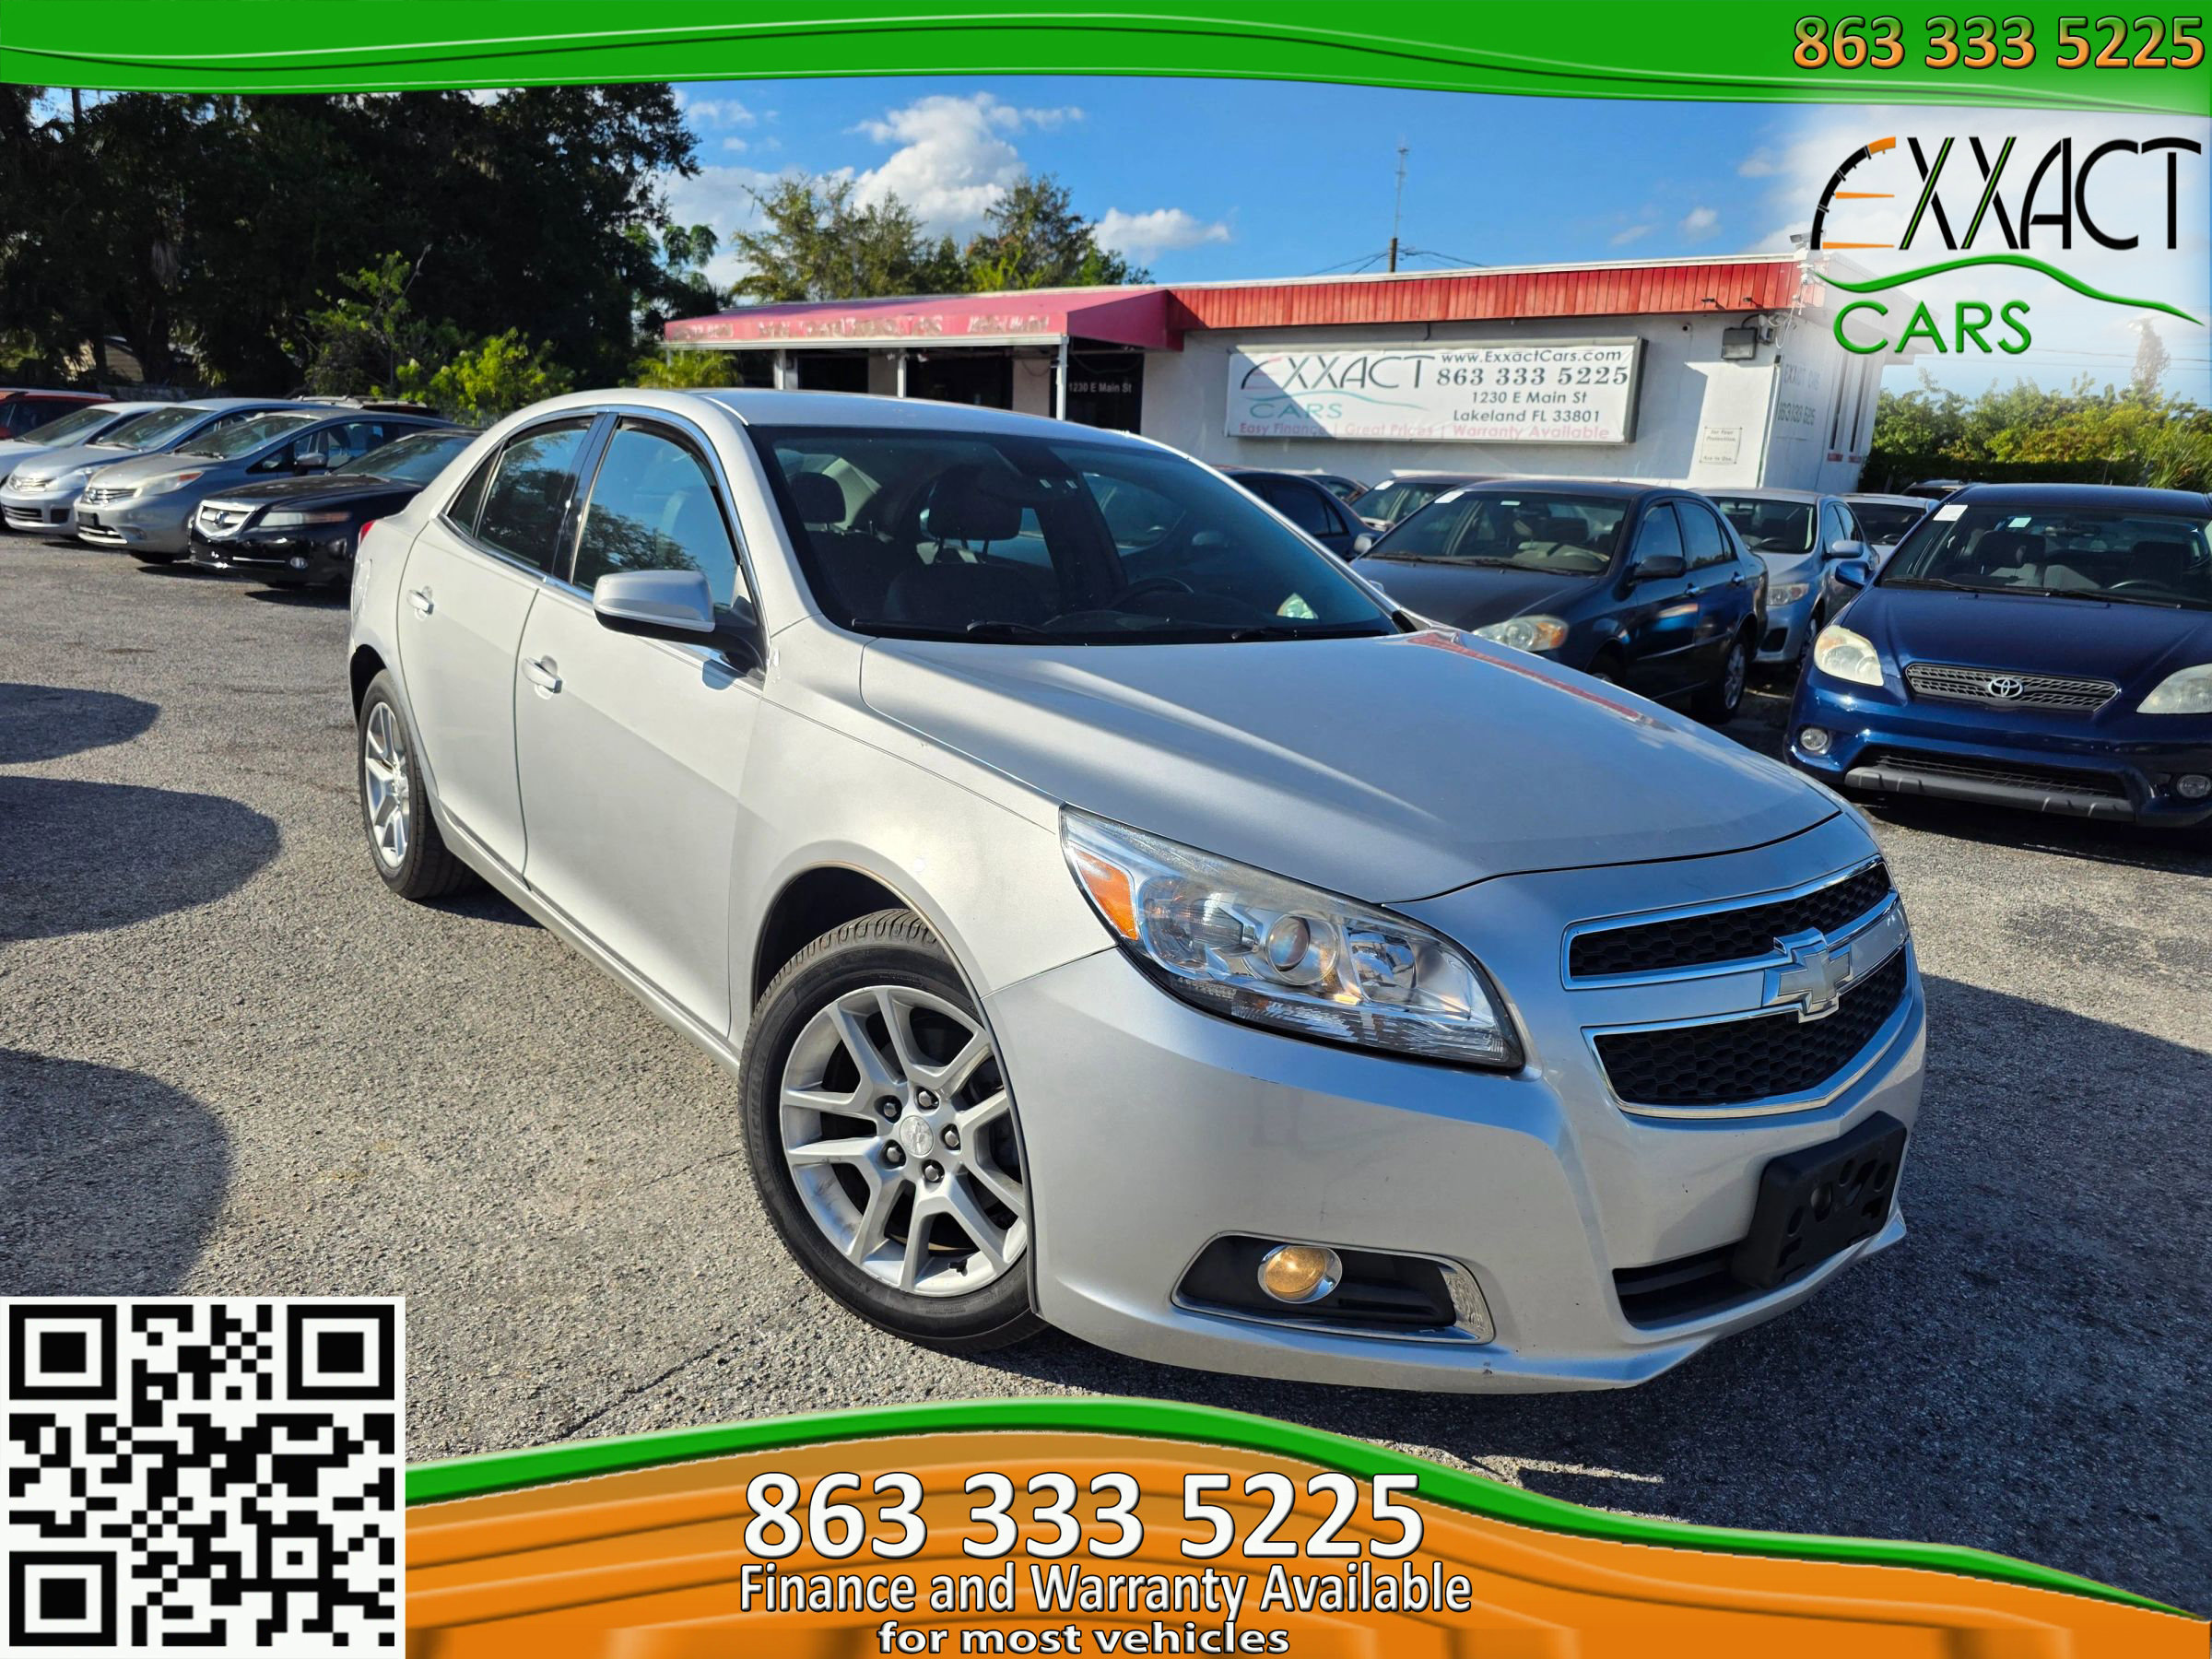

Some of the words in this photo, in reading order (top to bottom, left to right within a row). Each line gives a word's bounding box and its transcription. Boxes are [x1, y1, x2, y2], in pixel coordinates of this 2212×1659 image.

[1441, 349, 1621, 363] www.ExxactCars.com
[1241, 355, 1436, 390] EXXACT
[1437, 368, 1484, 386] 863
[1495, 367, 1546, 385] 333
[1558, 366, 1629, 385] 5225
[1090, 382, 1097, 393] E
[1099, 382, 1120, 393] Main
[1122, 382, 1132, 393] St
[1473, 391, 1507, 404] 1230
[1512, 392, 1521, 404] E
[1526, 391, 1567, 404] Main
[1572, 391, 1588, 404] St
[1249, 403, 1343, 418] CARS
[1453, 410, 1526, 423] Lakeland
[1532, 410, 1547, 422] FL
[1552, 410, 1600, 423] 33801
[1239, 422, 1269, 437] Easy
[1274, 422, 1325, 436] Finance
[1345, 423, 1386, 437] Great
[1390, 423, 1434, 438] Prices
[1453, 425, 1521, 440] Warranty
[1529, 425, 1610, 439] Available
